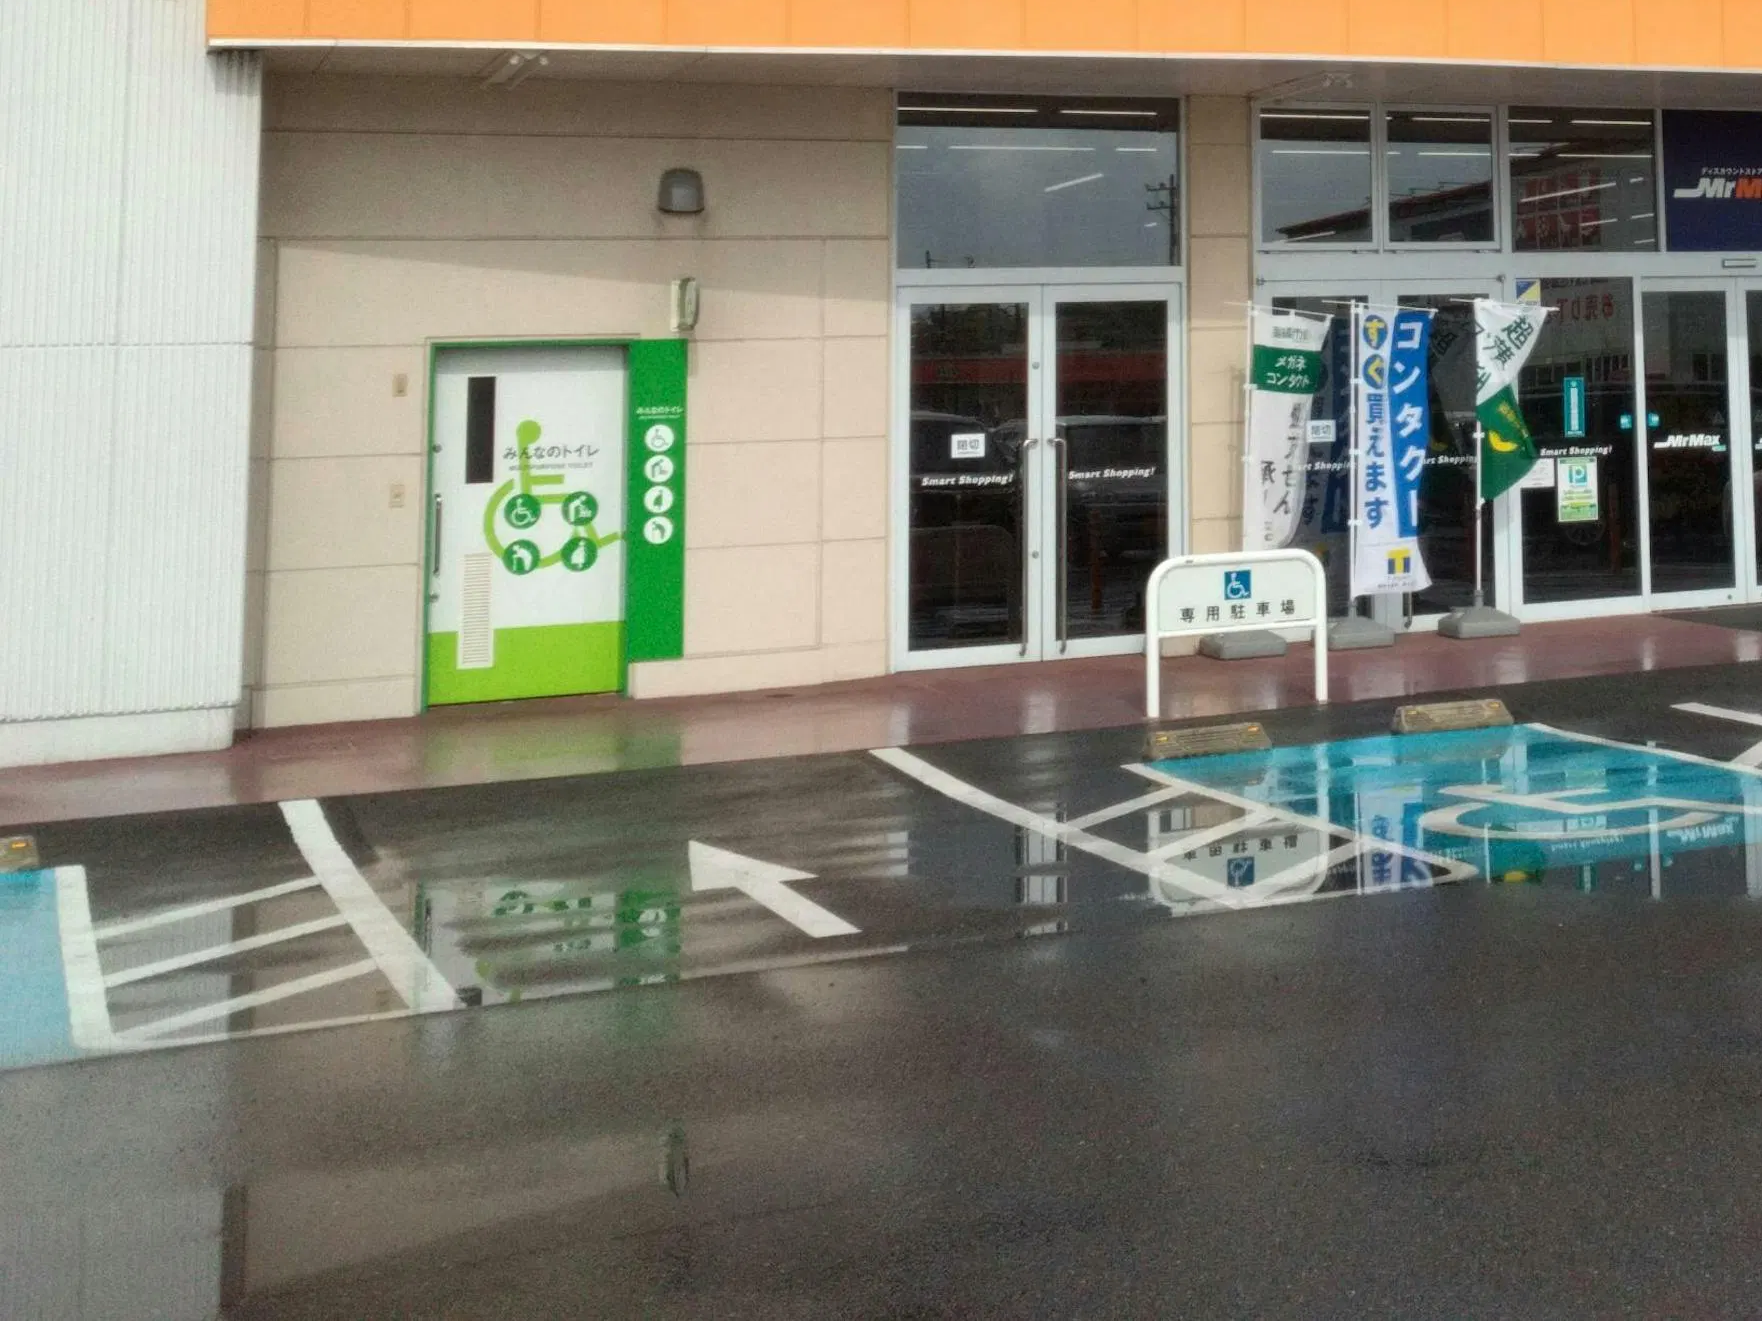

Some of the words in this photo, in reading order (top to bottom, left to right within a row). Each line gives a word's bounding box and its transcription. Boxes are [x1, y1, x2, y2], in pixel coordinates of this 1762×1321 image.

[1275, 355, 1306, 371] メガネ
[1266, 372, 1310, 388] コンタクト
[1654, 434, 1721, 449] MrMax
[503, 444, 600, 460] みんなのトイレ
[1540, 448, 1567, 456] Smart
[1569, 445, 1612, 456] Shopping!
[921, 477, 955, 487] Smart
[958, 474, 1014, 486] Shopping!
[1068, 470, 1100, 480] Smart
[1103, 467, 1156, 479] Shopping!
[1179, 599, 1296, 623] 専用駐車場
